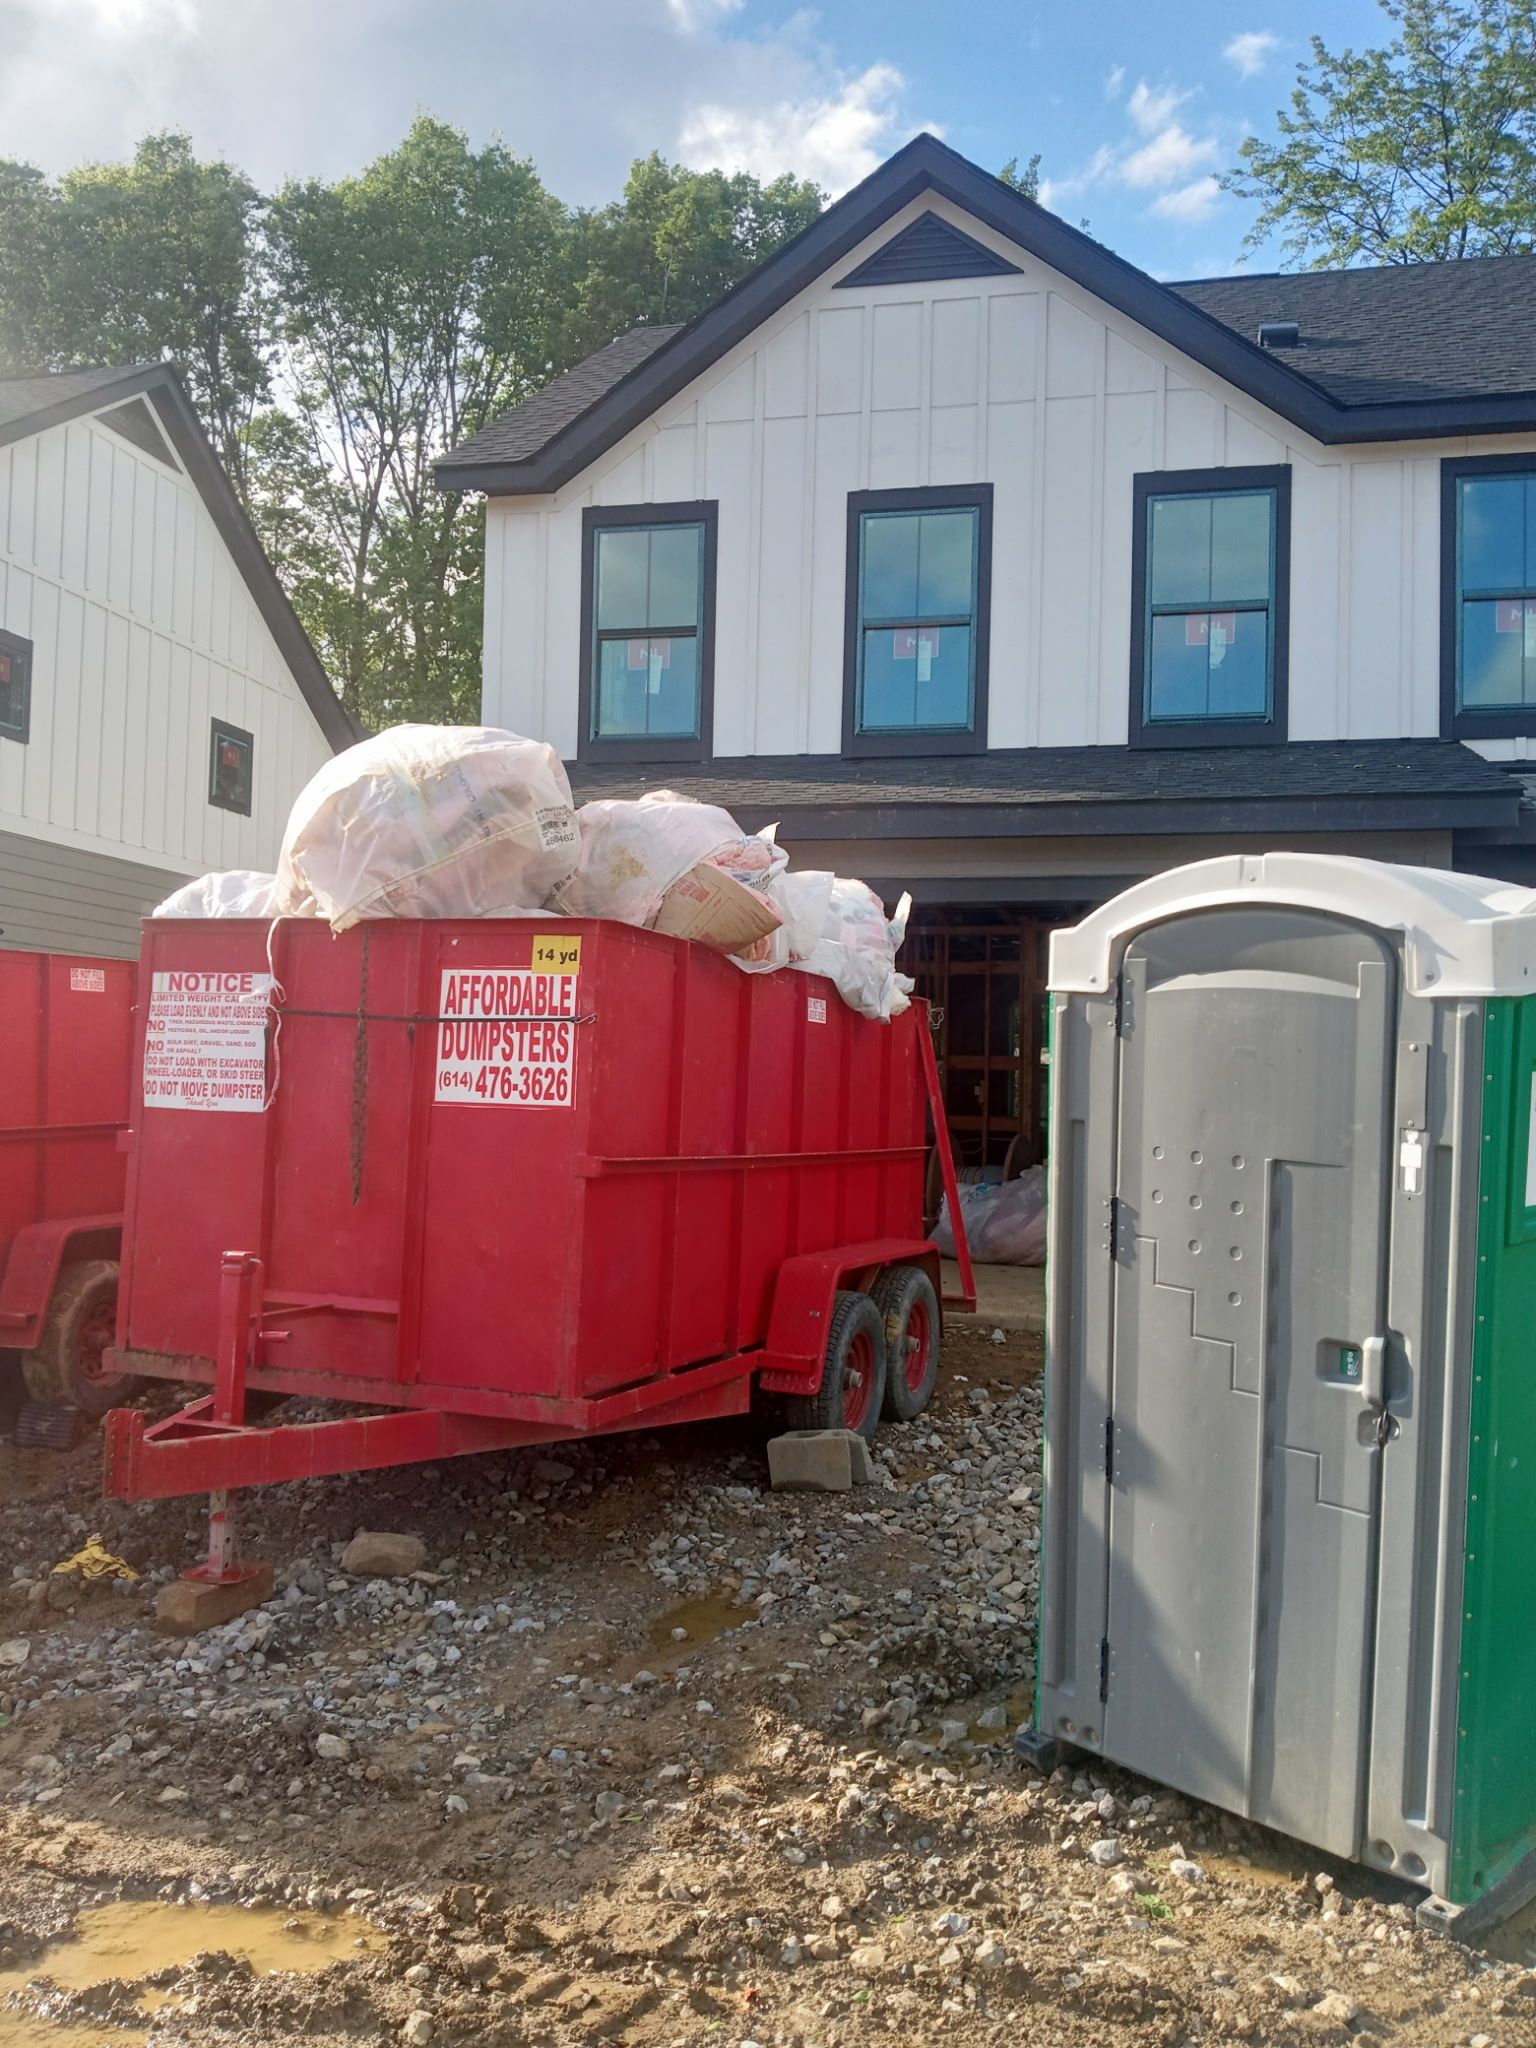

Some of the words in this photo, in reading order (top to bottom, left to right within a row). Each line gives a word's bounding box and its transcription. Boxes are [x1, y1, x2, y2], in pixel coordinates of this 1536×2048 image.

[537, 949, 555, 961] 14
[559, 949, 578, 964] yd
[168, 974, 253, 992] NOTICE
[152, 994, 185, 1002] LIMITED
[187, 994, 222, 1002] WEIGHT
[444, 975, 573, 1016] AFFORDABLE
[151, 1004, 170, 1017] PLEASE
[171, 1005, 185, 1017] LOAD
[186, 1005, 207, 1017] EVENLY
[207, 1005, 219, 1018] AND
[220, 1005, 232, 1018] NOT
[233, 1005, 251, 1018] ABOVE
[148, 1020, 166, 1031] NO
[147, 1040, 164, 1051] NO
[441, 1021, 570, 1063] DUMPSTERS
[148, 1055, 158, 1065] DO
[159, 1056, 174, 1066] NOT
[176, 1057, 196, 1067] LOAD
[197, 1058, 217, 1067] WITH
[219, 1059, 264, 1069] EXCAVATOR
[207, 1069, 217, 1078] OR
[219, 1070, 238, 1079] SKID
[240, 1070, 264, 1080] STEER
[145, 1080, 158, 1095] DO
[159, 1081, 179, 1096] NOT
[181, 1081, 208, 1097] MOVE
[211, 1083, 263, 1099] DUMPSTER
[439, 1071, 473, 1091] (614)
[475, 1065, 568, 1101] 476-3626
